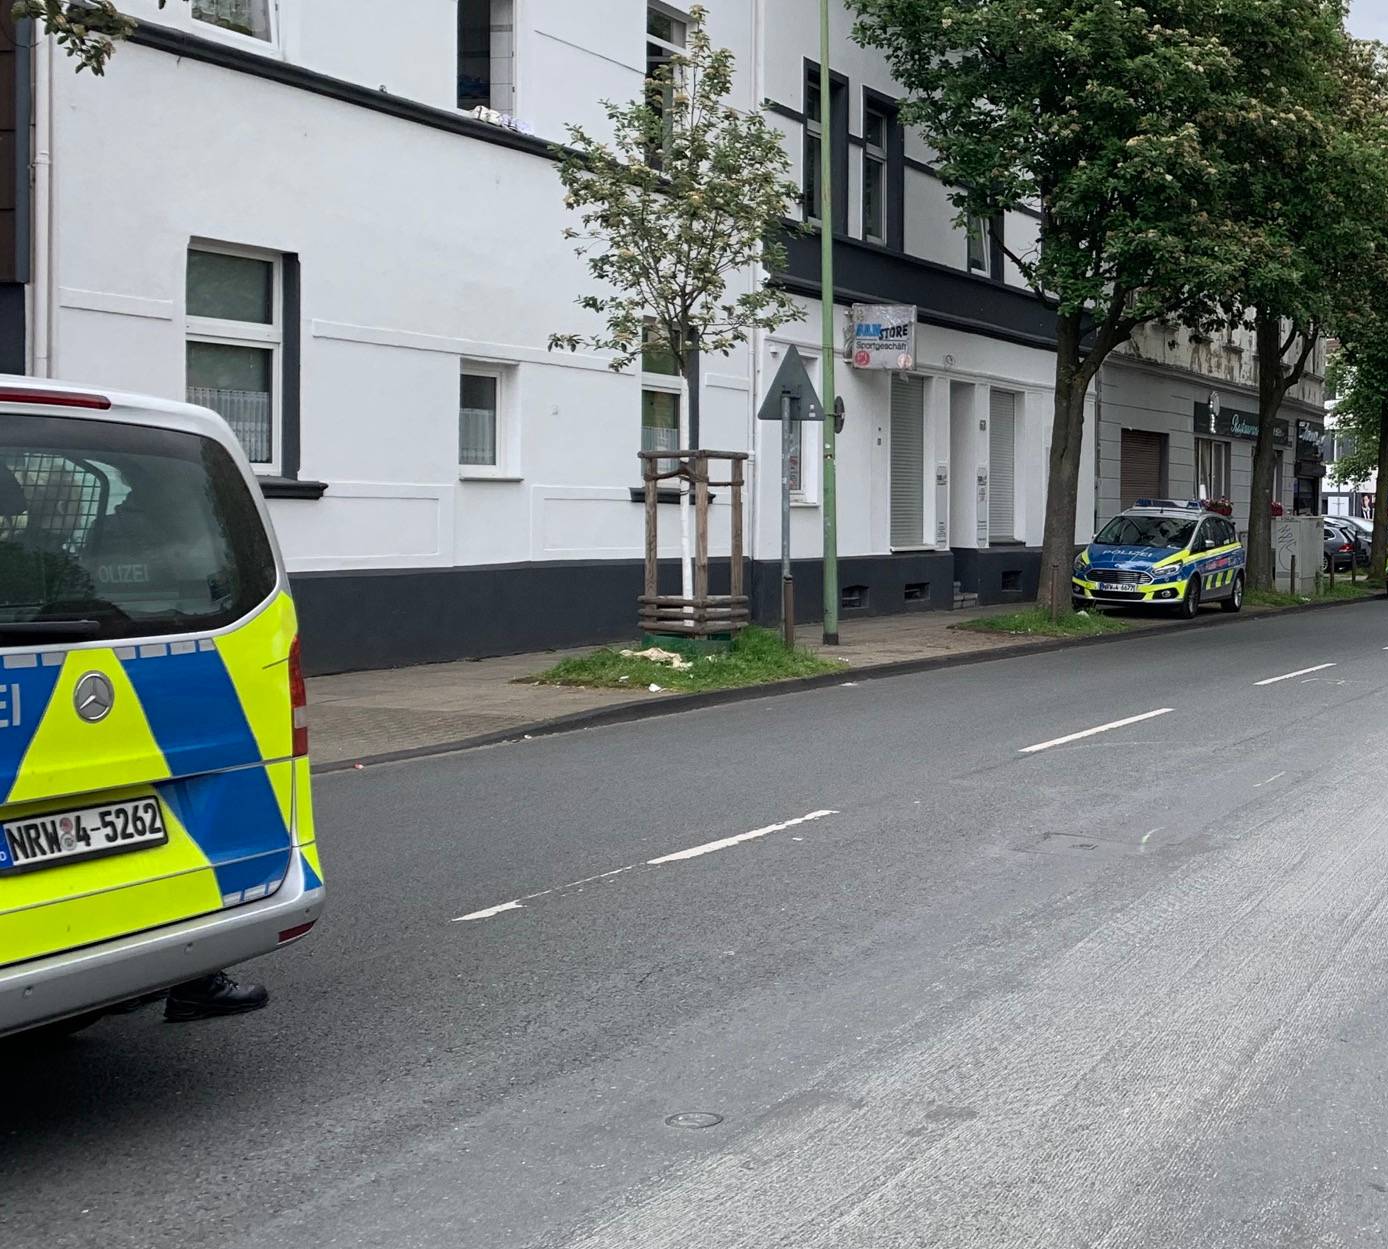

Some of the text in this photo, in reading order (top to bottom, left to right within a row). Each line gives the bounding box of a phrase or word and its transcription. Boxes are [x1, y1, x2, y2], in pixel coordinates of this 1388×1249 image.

[1102, 549, 1153, 558] POLIZEI
[6, 802, 162, 862] NRW 4-5262
